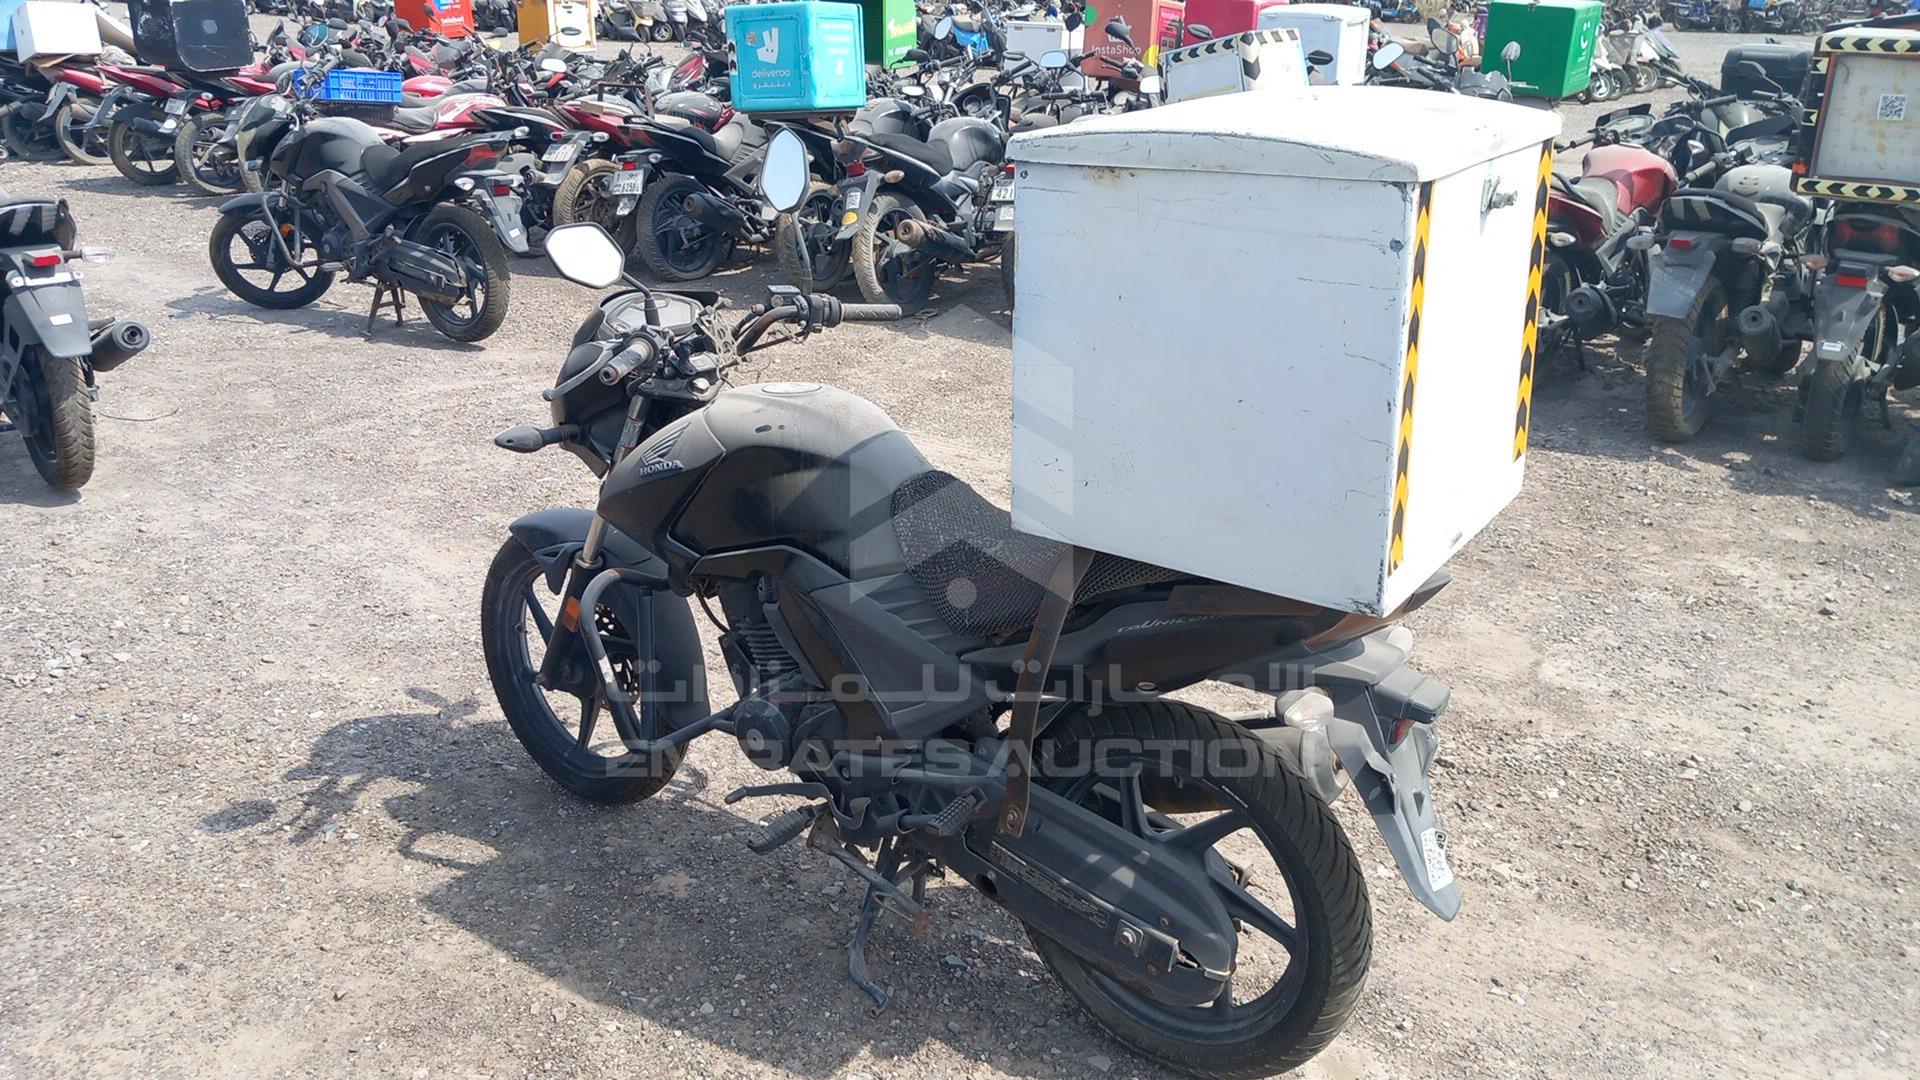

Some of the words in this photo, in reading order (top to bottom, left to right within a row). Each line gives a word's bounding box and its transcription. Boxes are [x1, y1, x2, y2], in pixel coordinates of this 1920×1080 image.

[1091, 44, 1142, 55] InstaShop
[751, 68, 791, 78] deliveroo
[640, 460, 685, 475] HONDA
